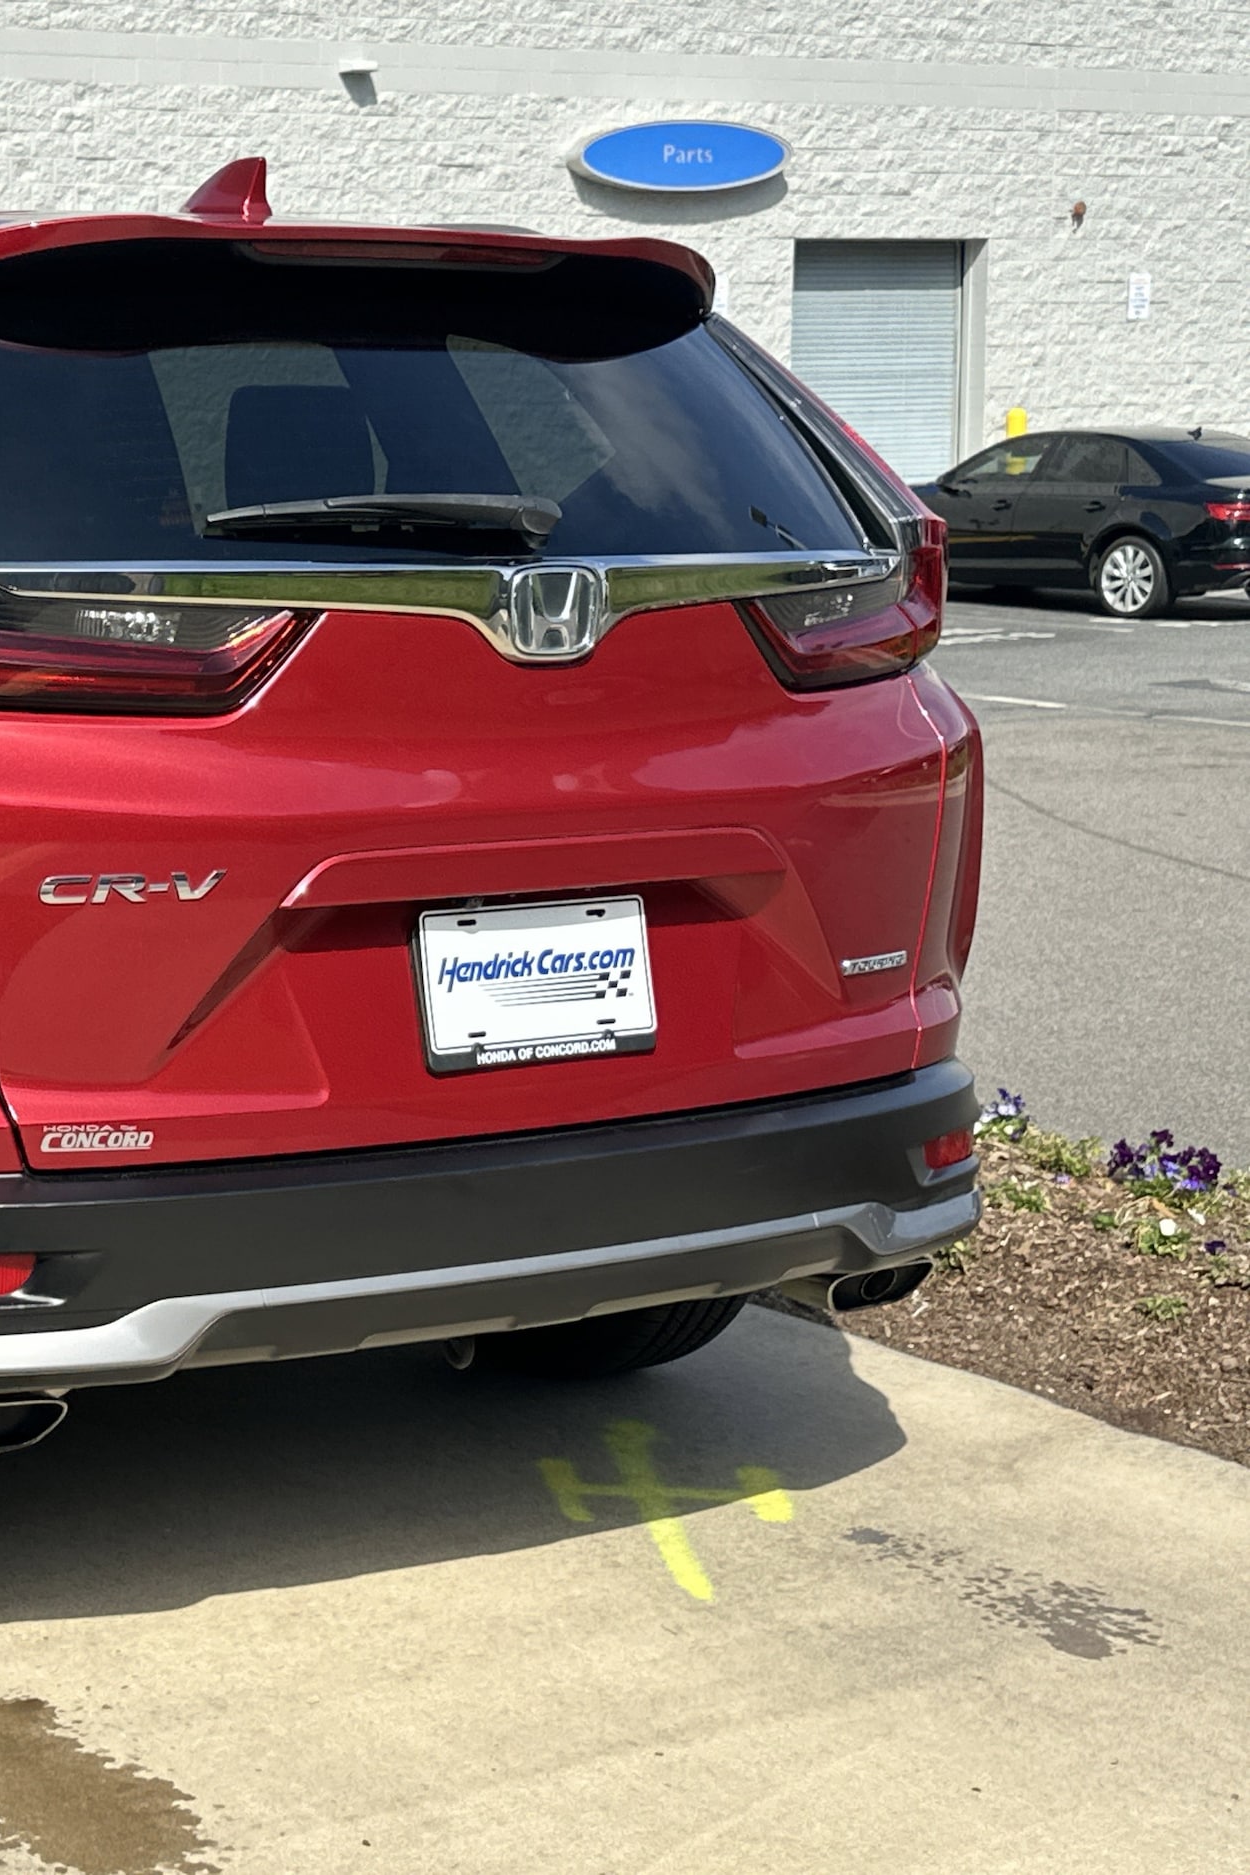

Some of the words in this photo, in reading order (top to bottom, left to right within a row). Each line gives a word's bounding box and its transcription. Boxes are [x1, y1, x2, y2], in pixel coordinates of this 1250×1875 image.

[663, 144, 713, 164] Parts
[39, 869, 228, 905] CR-V
[437, 951, 535, 993] Hendrick
[537, 948, 636, 976] Cars.com
[476, 1049, 517, 1066] HONDA
[517, 1047, 534, 1061] OF
[534, 1038, 617, 1060] CONCORD.COM
[43, 1124, 114, 1132] HONDA
[40, 1131, 154, 1152] CONCORD
